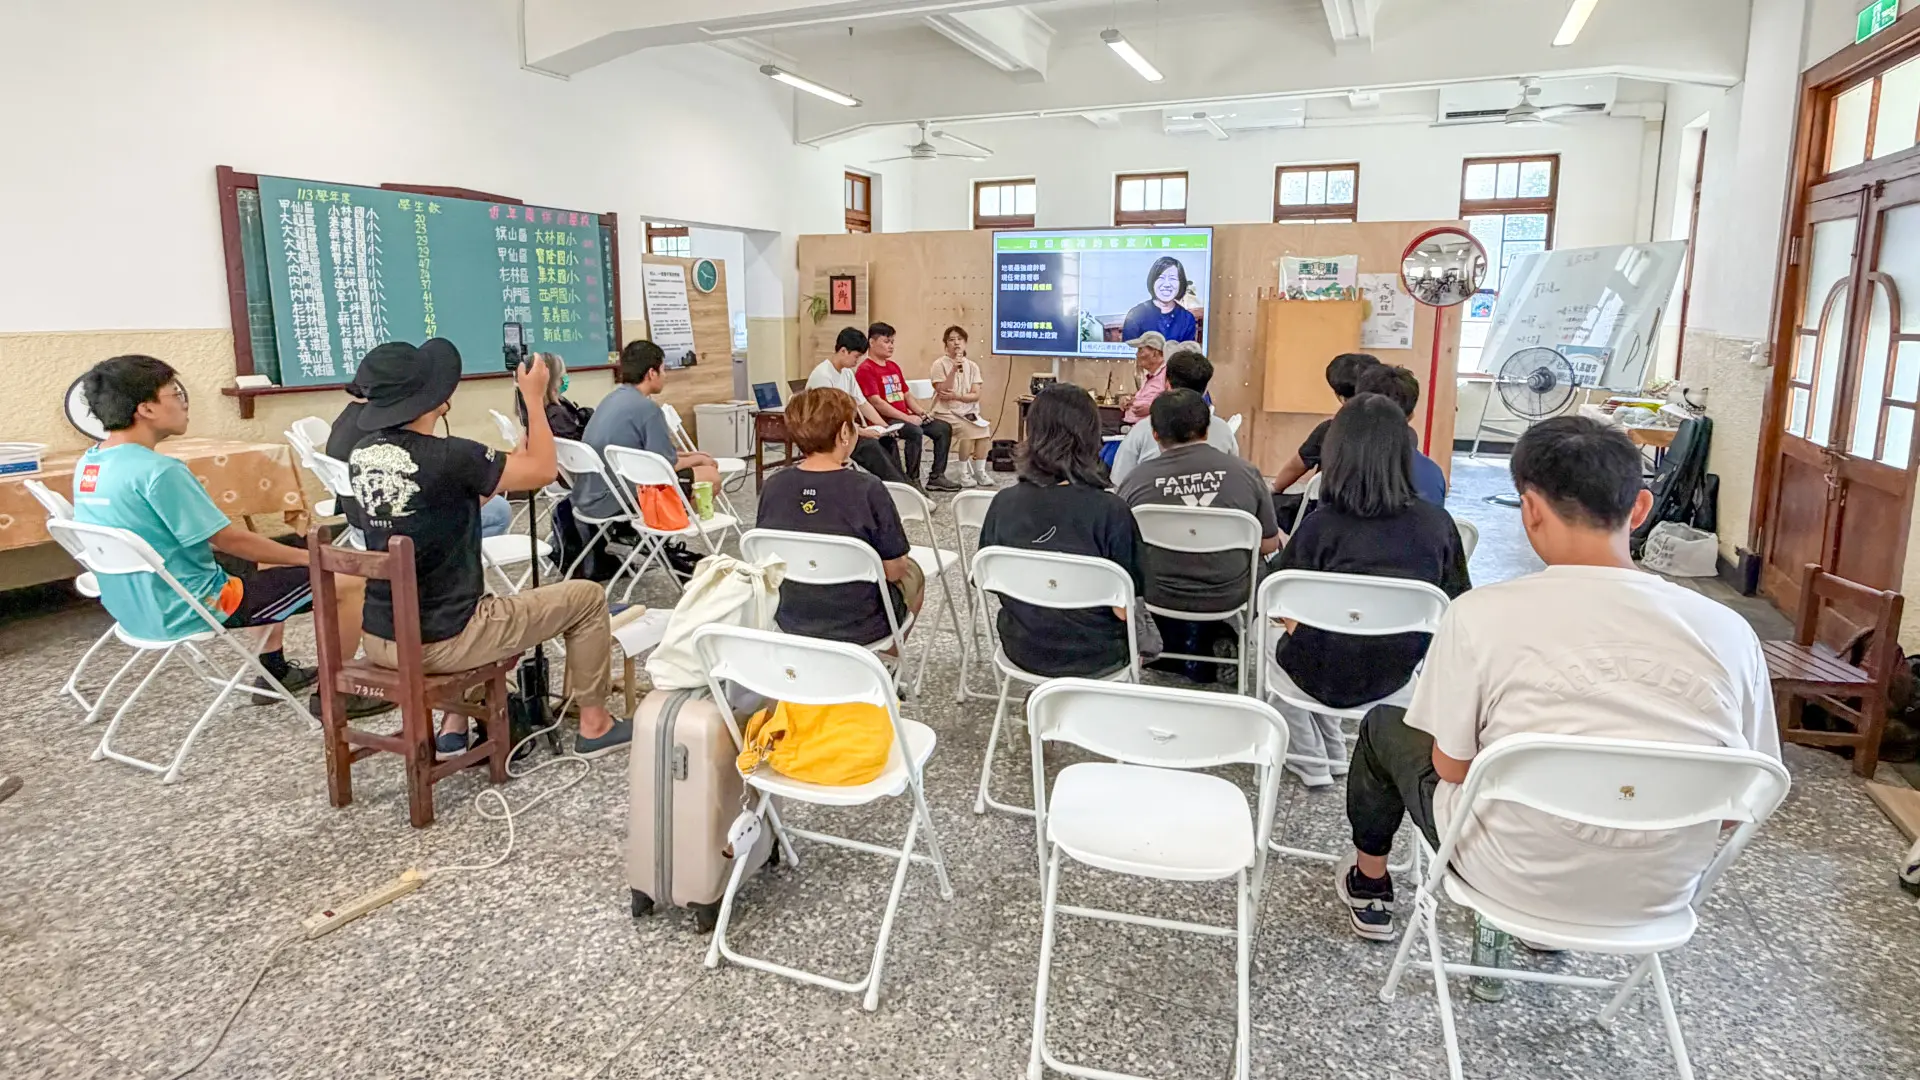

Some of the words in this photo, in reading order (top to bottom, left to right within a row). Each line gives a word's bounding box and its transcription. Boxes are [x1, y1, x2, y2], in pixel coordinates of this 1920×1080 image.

[297, 188, 352, 205] 113學年度
[279, 199, 314, 214] 甲仙區
[328, 204, 380, 220] 小林國小
[535, 229, 577, 246] 大林國小
[498, 247, 528, 264] 甲仙區
[499, 267, 529, 284] 杉林區
[422, 291, 433, 301] 41
[292, 301, 327, 316] 杉林區
[424, 303, 434, 313] 35
[292, 314, 329, 328] 杉林區
[424, 314, 436, 325] 42
[293, 326, 331, 340] 杉林區
[1155, 470, 1227, 488] FATFAT
[1163, 481, 1221, 497] FAMILY
